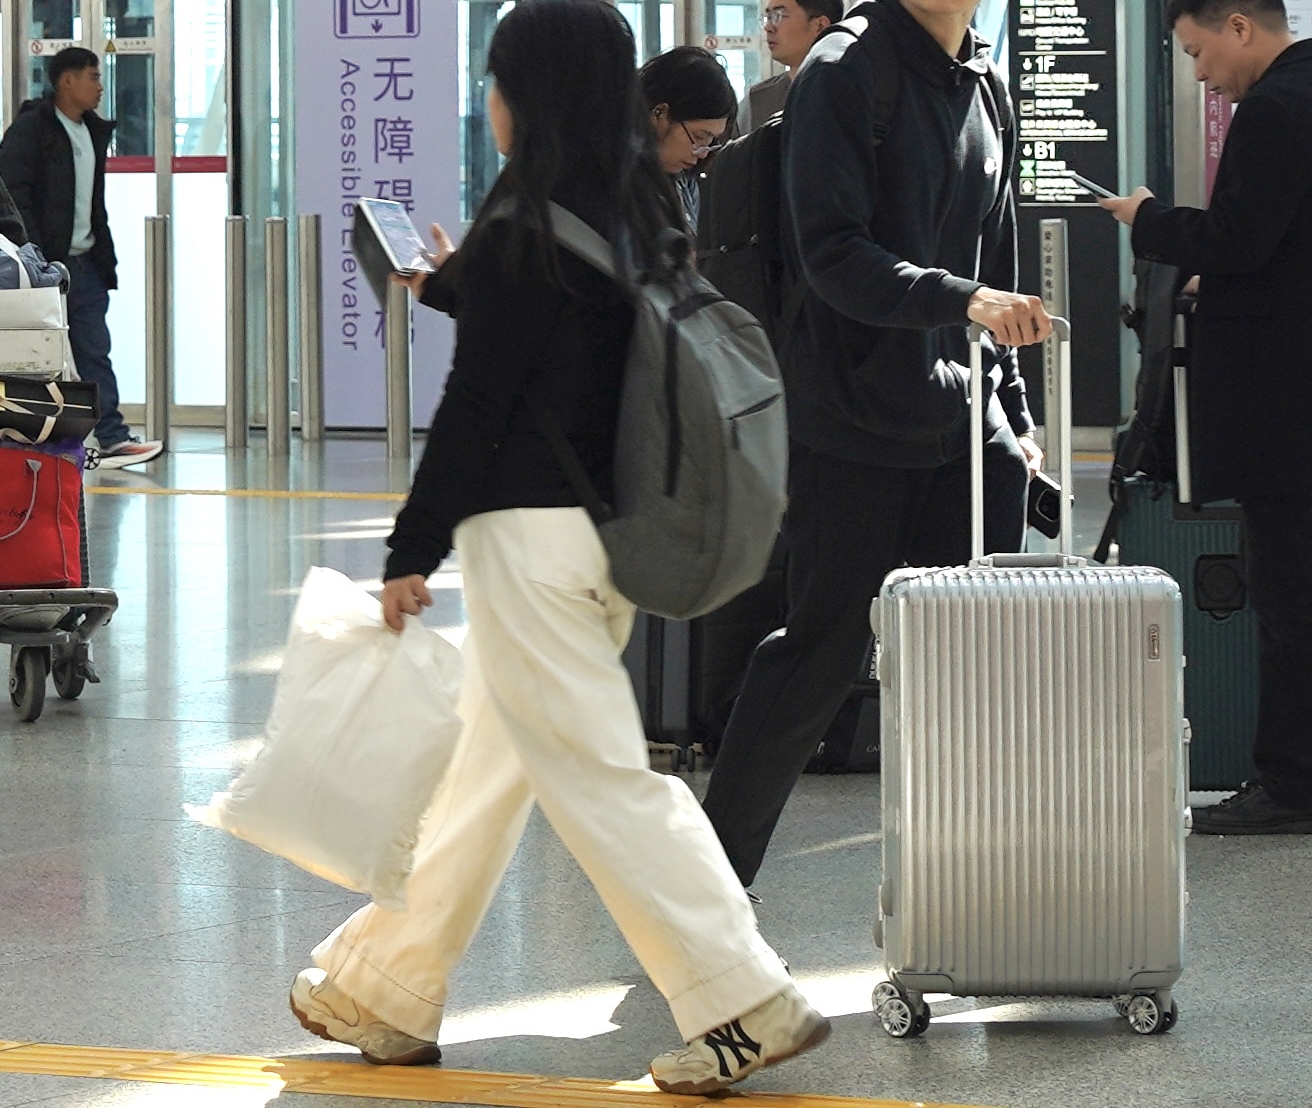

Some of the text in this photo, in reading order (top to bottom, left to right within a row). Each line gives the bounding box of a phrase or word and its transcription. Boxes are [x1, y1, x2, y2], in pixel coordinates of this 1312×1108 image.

[1034, 55, 1056, 73] 1F
[340, 58, 362, 218] Accessible
[1034, 141, 1056, 159] B1
